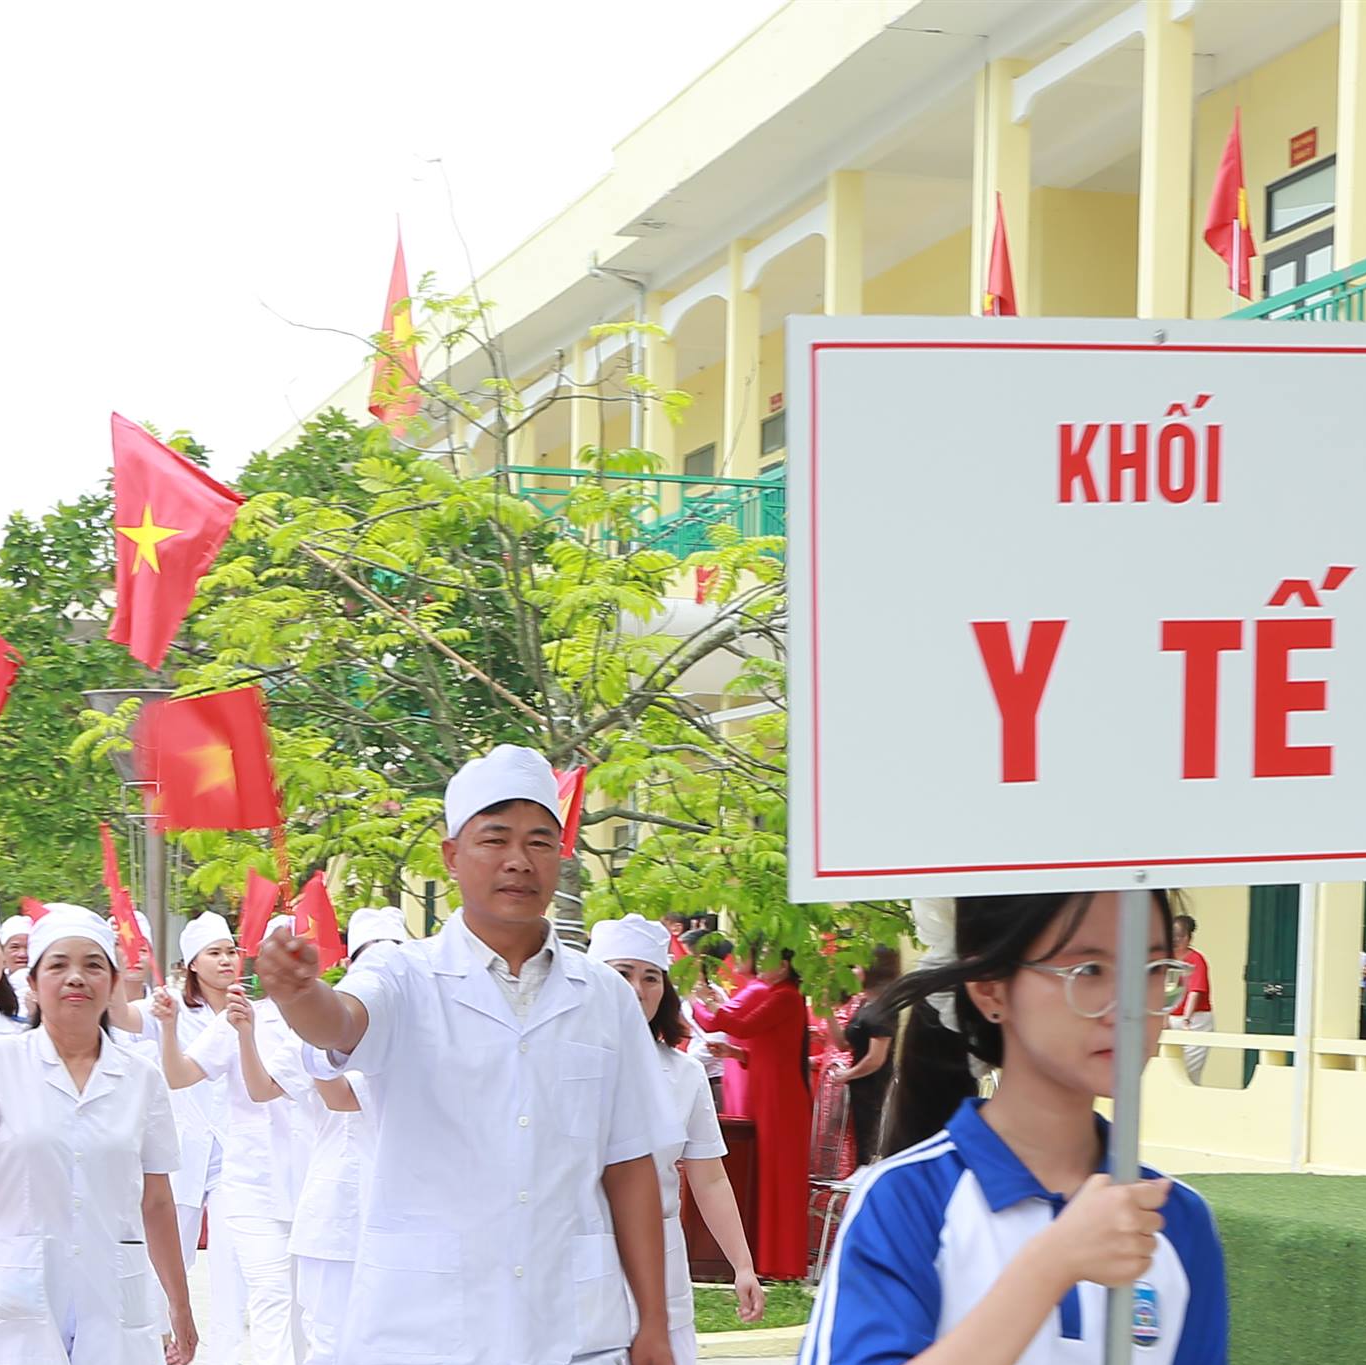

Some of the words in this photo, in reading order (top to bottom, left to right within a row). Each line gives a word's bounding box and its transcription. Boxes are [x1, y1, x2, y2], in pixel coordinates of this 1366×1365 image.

[1057, 394, 1223, 504] KHỐI
[970, 619, 1069, 783] Y
[1159, 566, 1357, 779] TẾ
